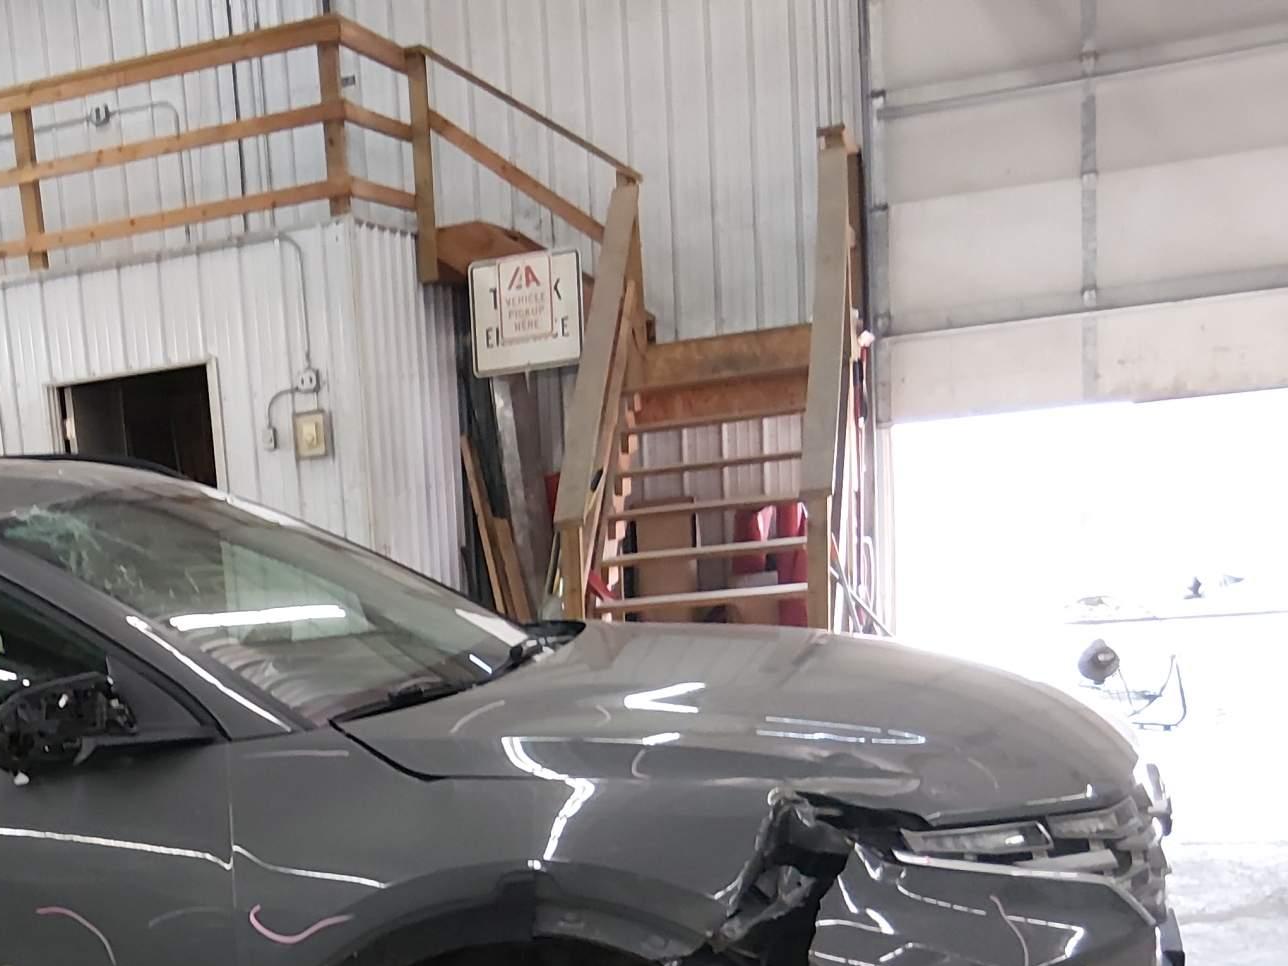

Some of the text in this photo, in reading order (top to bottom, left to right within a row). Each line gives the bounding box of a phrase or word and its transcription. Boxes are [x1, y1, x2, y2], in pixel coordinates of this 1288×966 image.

[505, 292, 546, 307] VEHICLE
[508, 306, 545, 320] PICKUP
[514, 319, 539, 332] HERE
